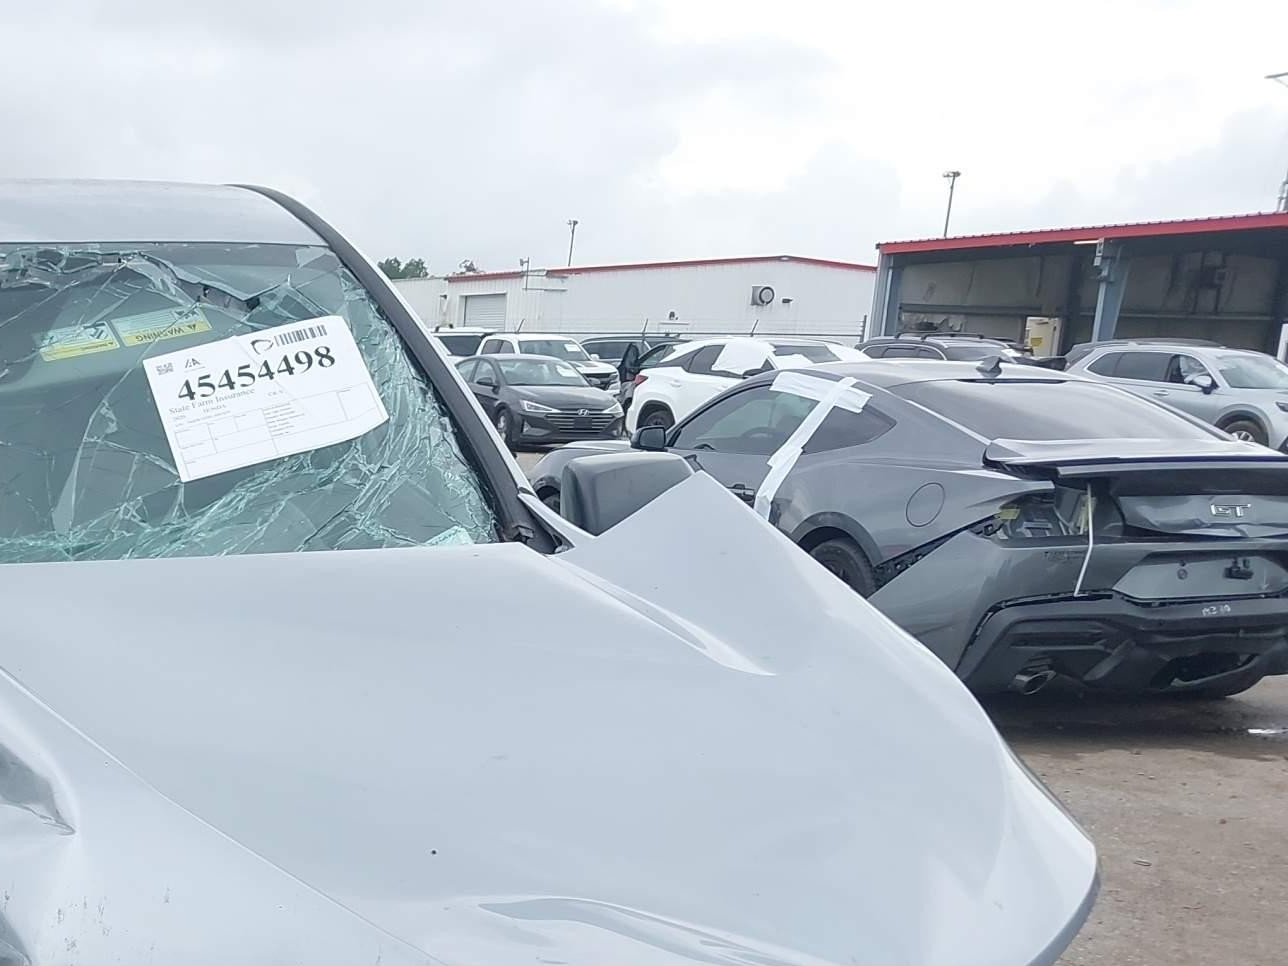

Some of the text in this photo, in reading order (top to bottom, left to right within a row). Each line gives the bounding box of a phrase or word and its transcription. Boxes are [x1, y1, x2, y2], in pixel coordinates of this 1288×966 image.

[178, 346, 336, 401] 45454498
[169, 388, 255, 414] State Farm Insurance
[1211, 504, 1251, 516] GT
